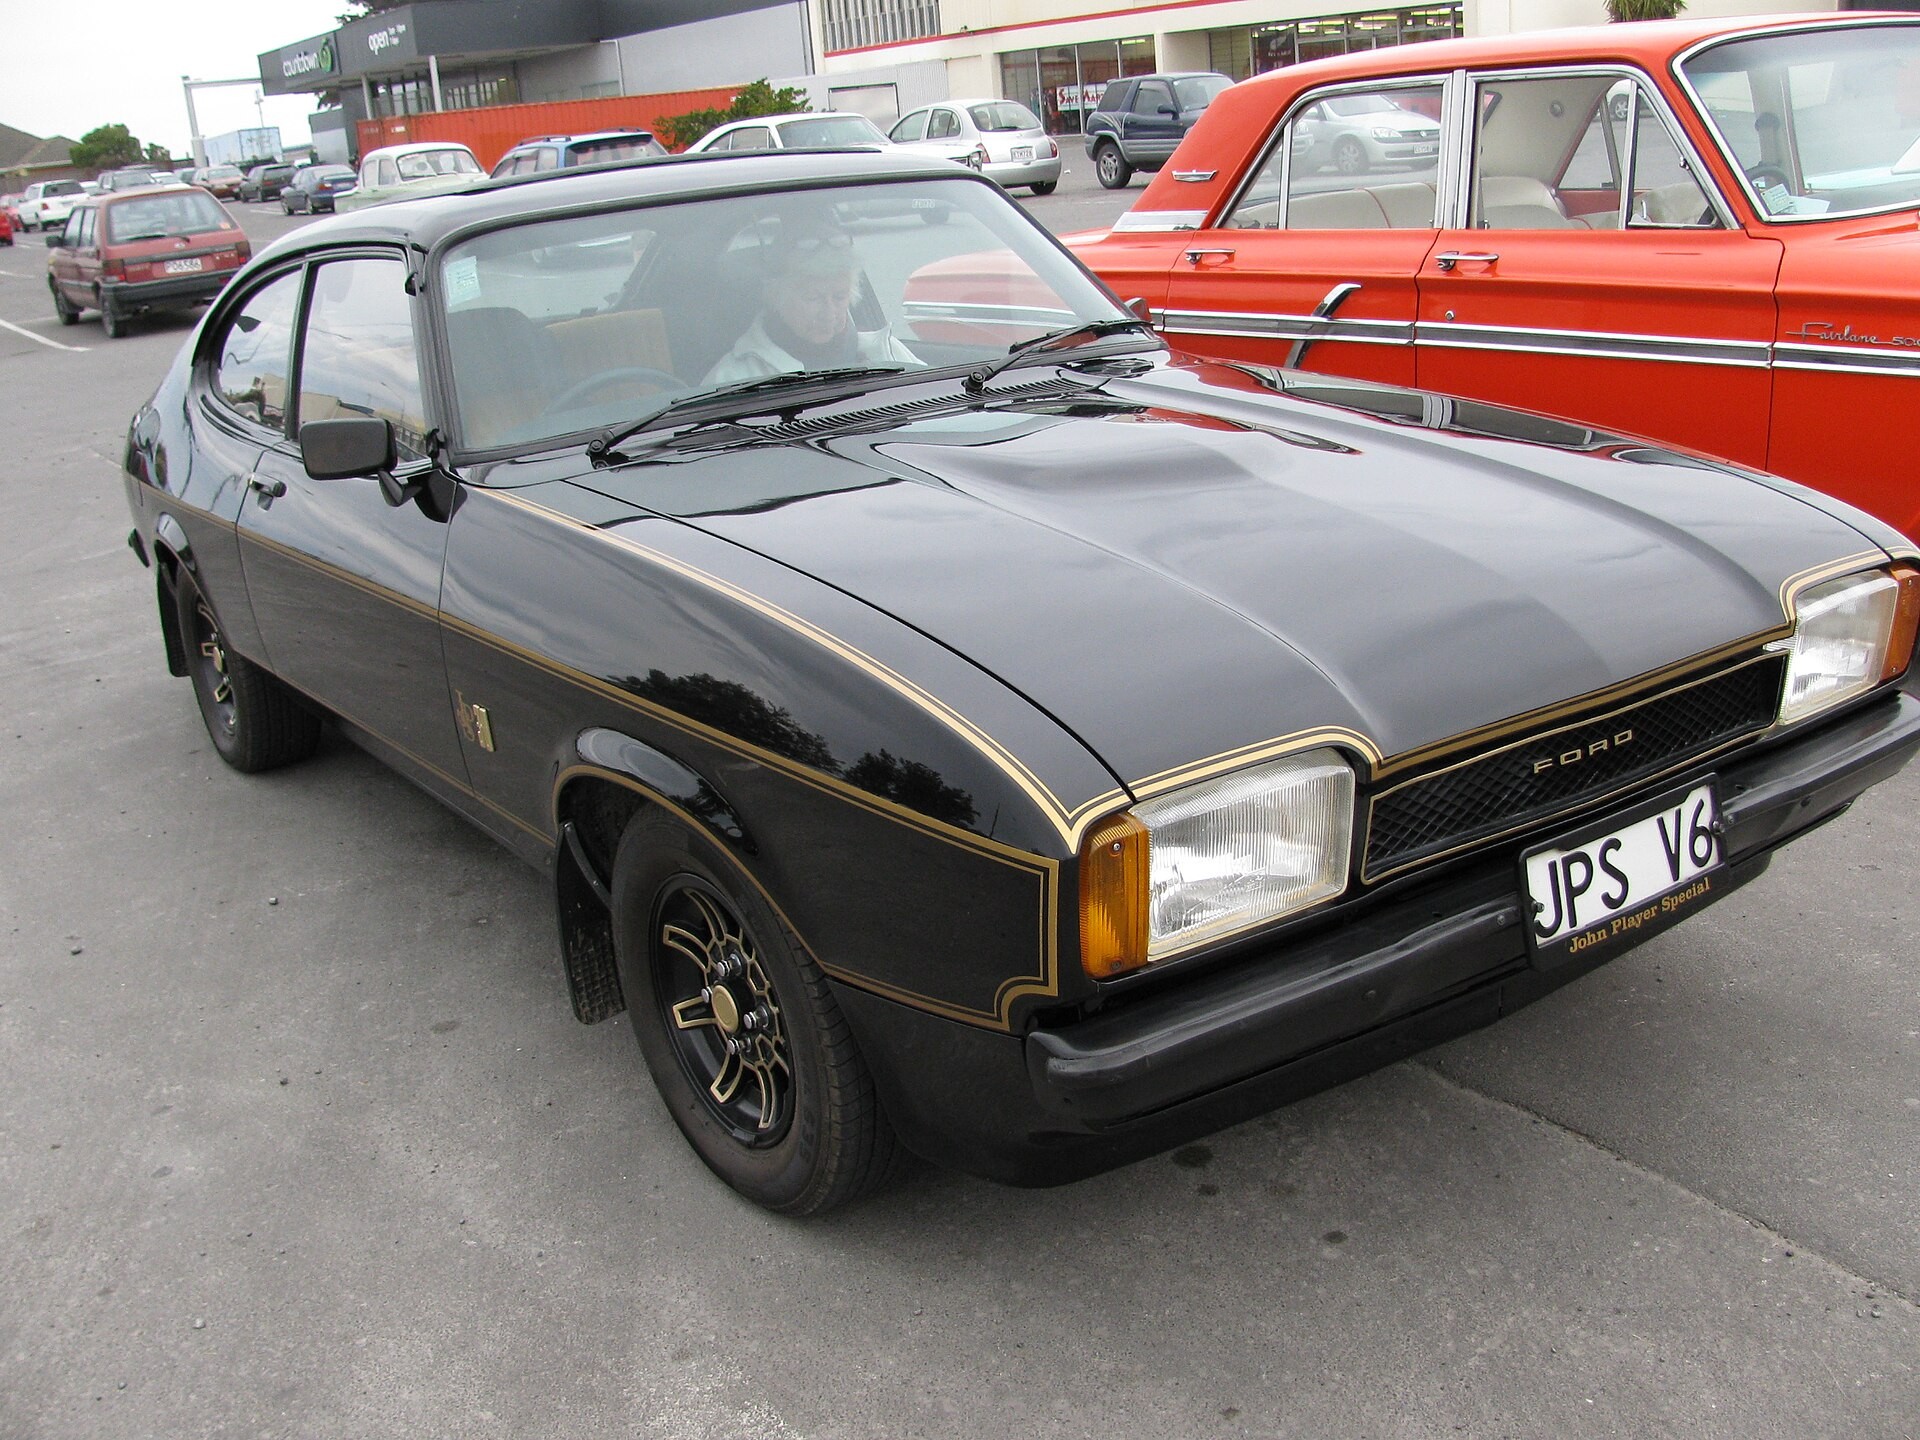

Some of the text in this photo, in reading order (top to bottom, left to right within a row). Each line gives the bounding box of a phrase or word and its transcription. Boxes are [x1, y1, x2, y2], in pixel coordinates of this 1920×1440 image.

[368, 30, 390, 55] open
[1785, 321, 1880, 343] Fairlane
[1534, 730, 1633, 774] FORD
[1534, 798, 1713, 938] JPS V6
[1569, 877, 1711, 953] John Player Special
